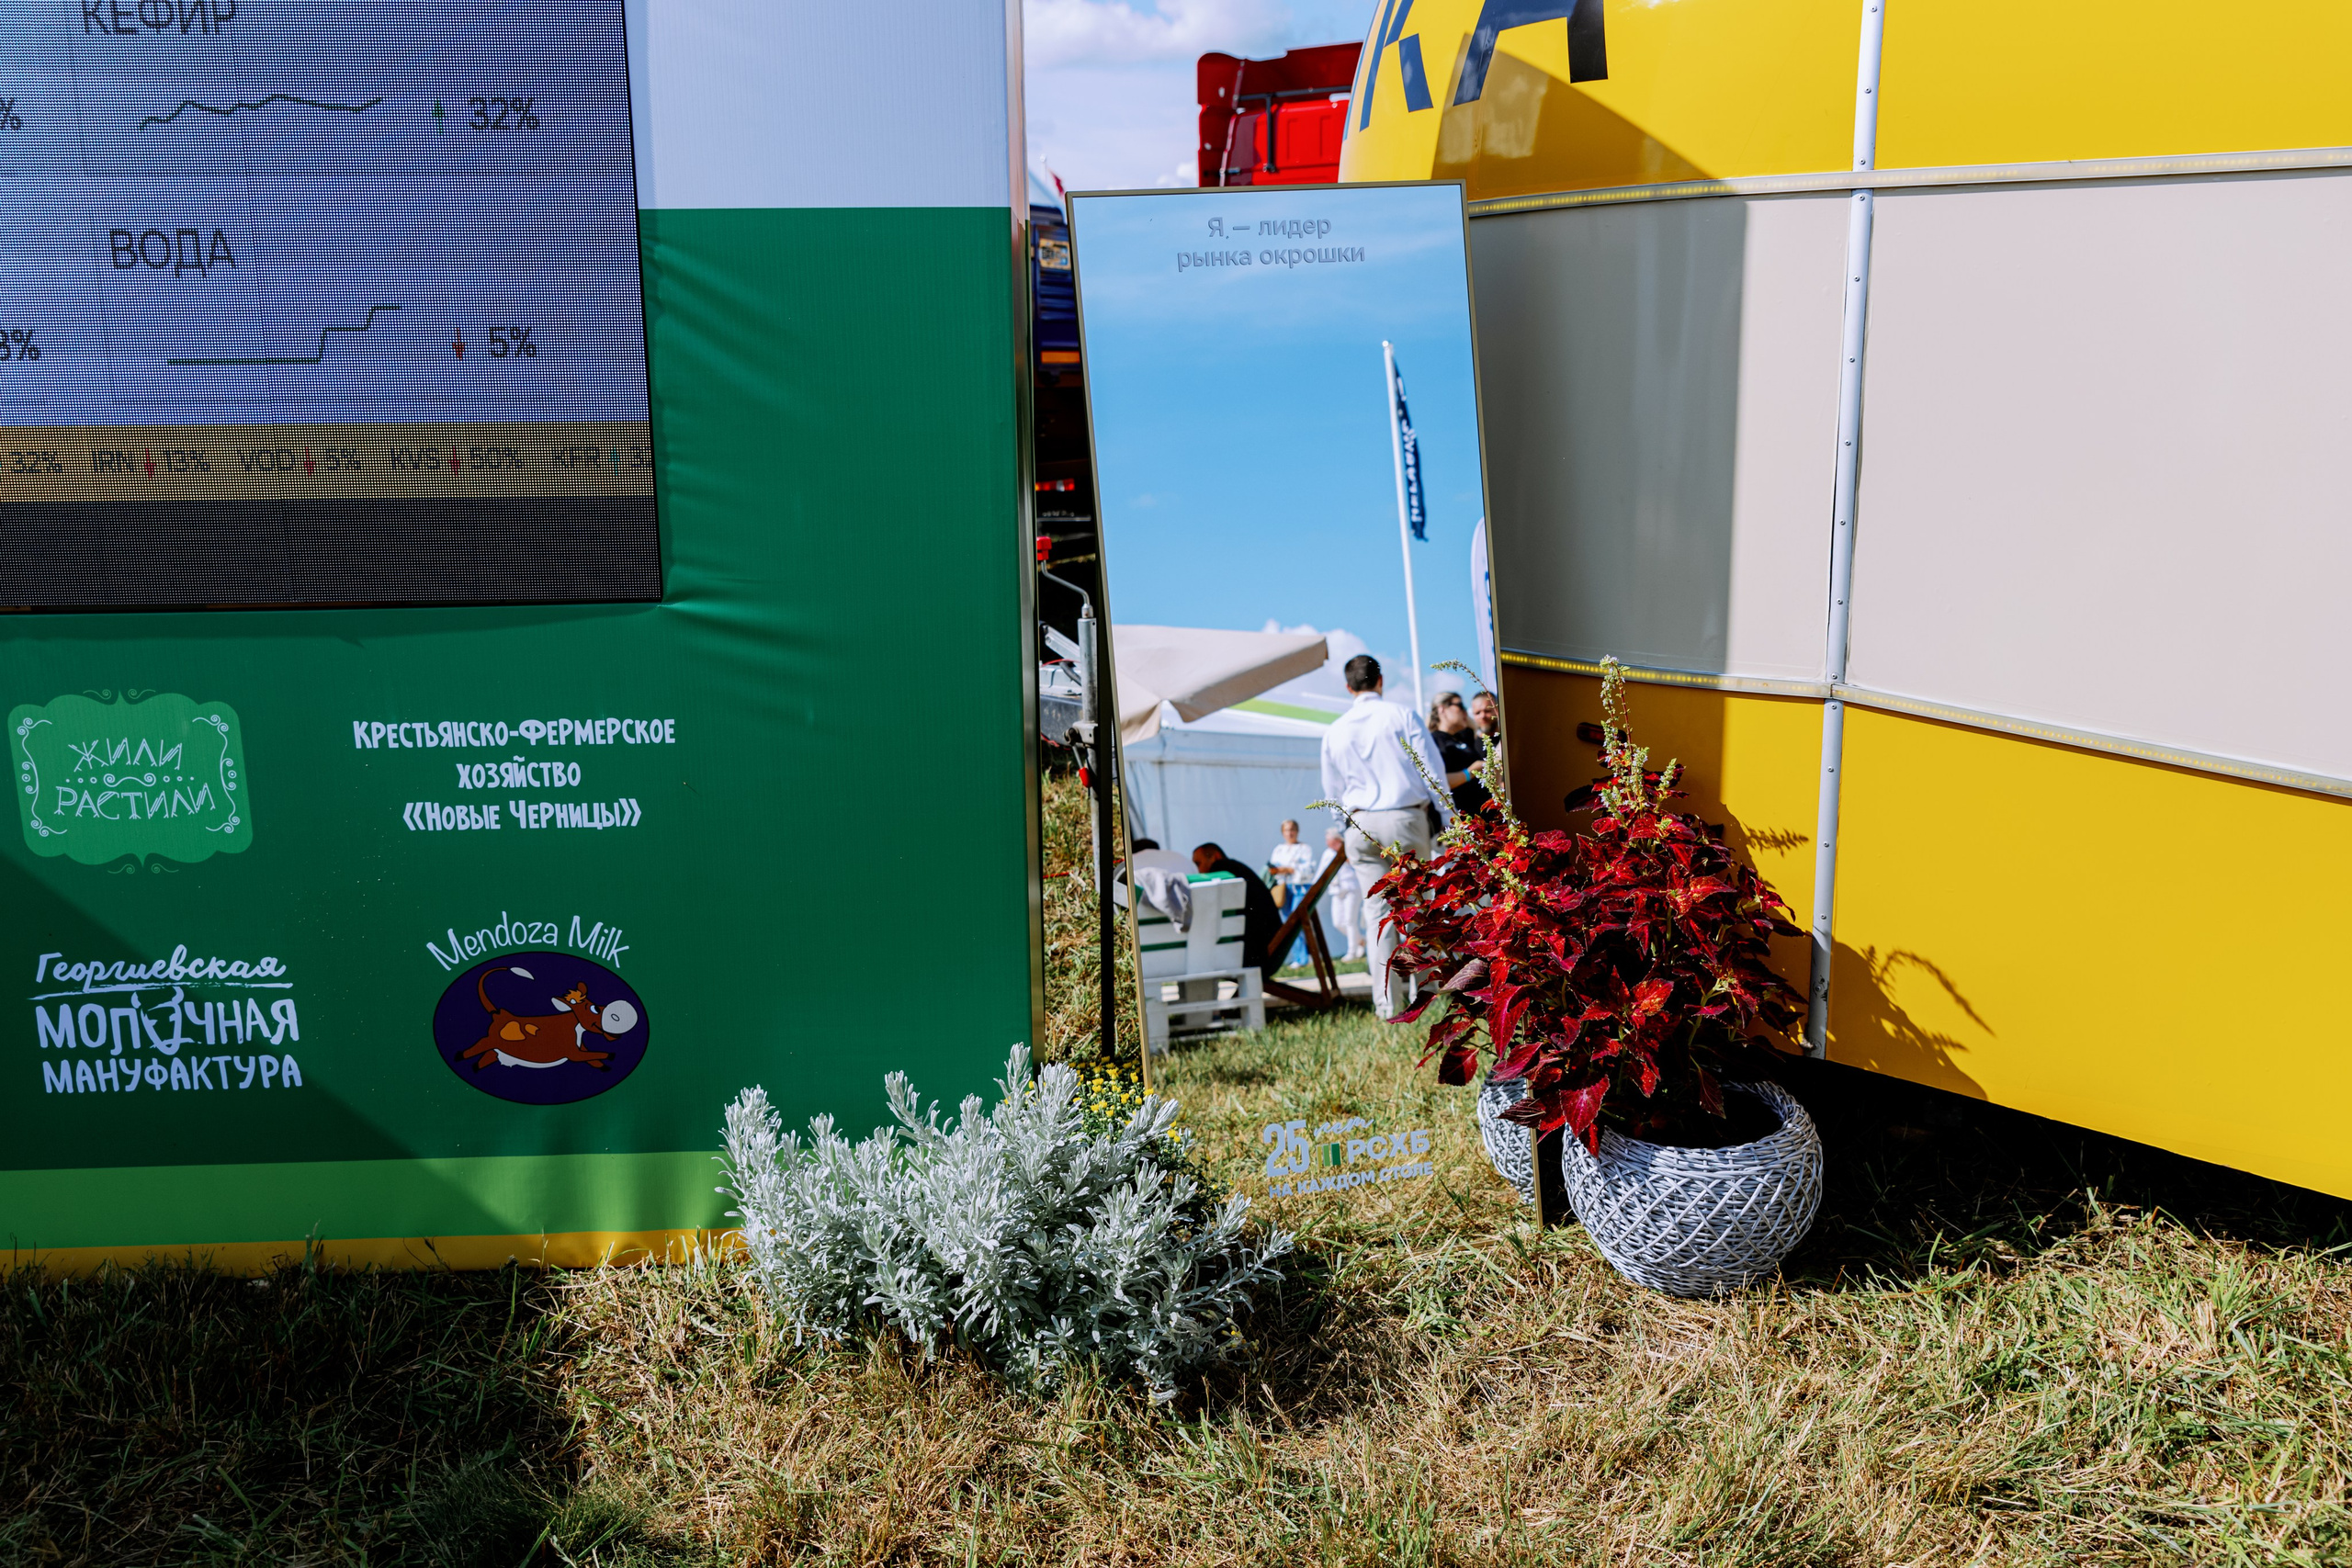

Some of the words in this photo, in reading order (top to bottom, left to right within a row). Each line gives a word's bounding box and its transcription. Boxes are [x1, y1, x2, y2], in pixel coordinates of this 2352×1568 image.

[82, 0, 237, 35] КЕФИР
[468, 96, 540, 130] 32%
[1207, 217, 1224, 238] Я
[1259, 218, 1332, 240] лидер
[108, 228, 237, 278] ВОДА
[1177, 249, 1252, 273] рынка
[1259, 246, 1366, 269] окрошки
[489, 325, 537, 359] 5%
[10, 448, 62, 474] 32%
[92, 448, 135, 473] IRN
[163, 448, 211, 473] 13%
[237, 447, 296, 472] VOD
[325, 447, 362, 471] 5%
[390, 446, 440, 470] KVS
[469, 446, 525, 470] 50%
[552, 446, 601, 468] KFR
[353, 717, 675, 749] КРЕСТЬЯНСКО-ФЕРМЕРСКОЕ
[68, 738, 182, 773] ЖИЛИ
[456, 755, 581, 789] ХОЗЯЙСТВО
[54, 783, 216, 819] РАСТИЛИ
[426, 911, 558, 971] Mendoza
[569, 915, 629, 968] Milk
[36, 944, 287, 993] Георгиевская
[42, 1055, 302, 1093] МАНУФАКТУРА
[1263, 1119, 1310, 1178] 25
[1347, 1130, 1430, 1164] РСХБ
[1269, 1184, 1294, 1199] НА
[1297, 1170, 1375, 1194] КАЖДОМ
[1380, 1161, 1433, 1182] СТОЛЕ
